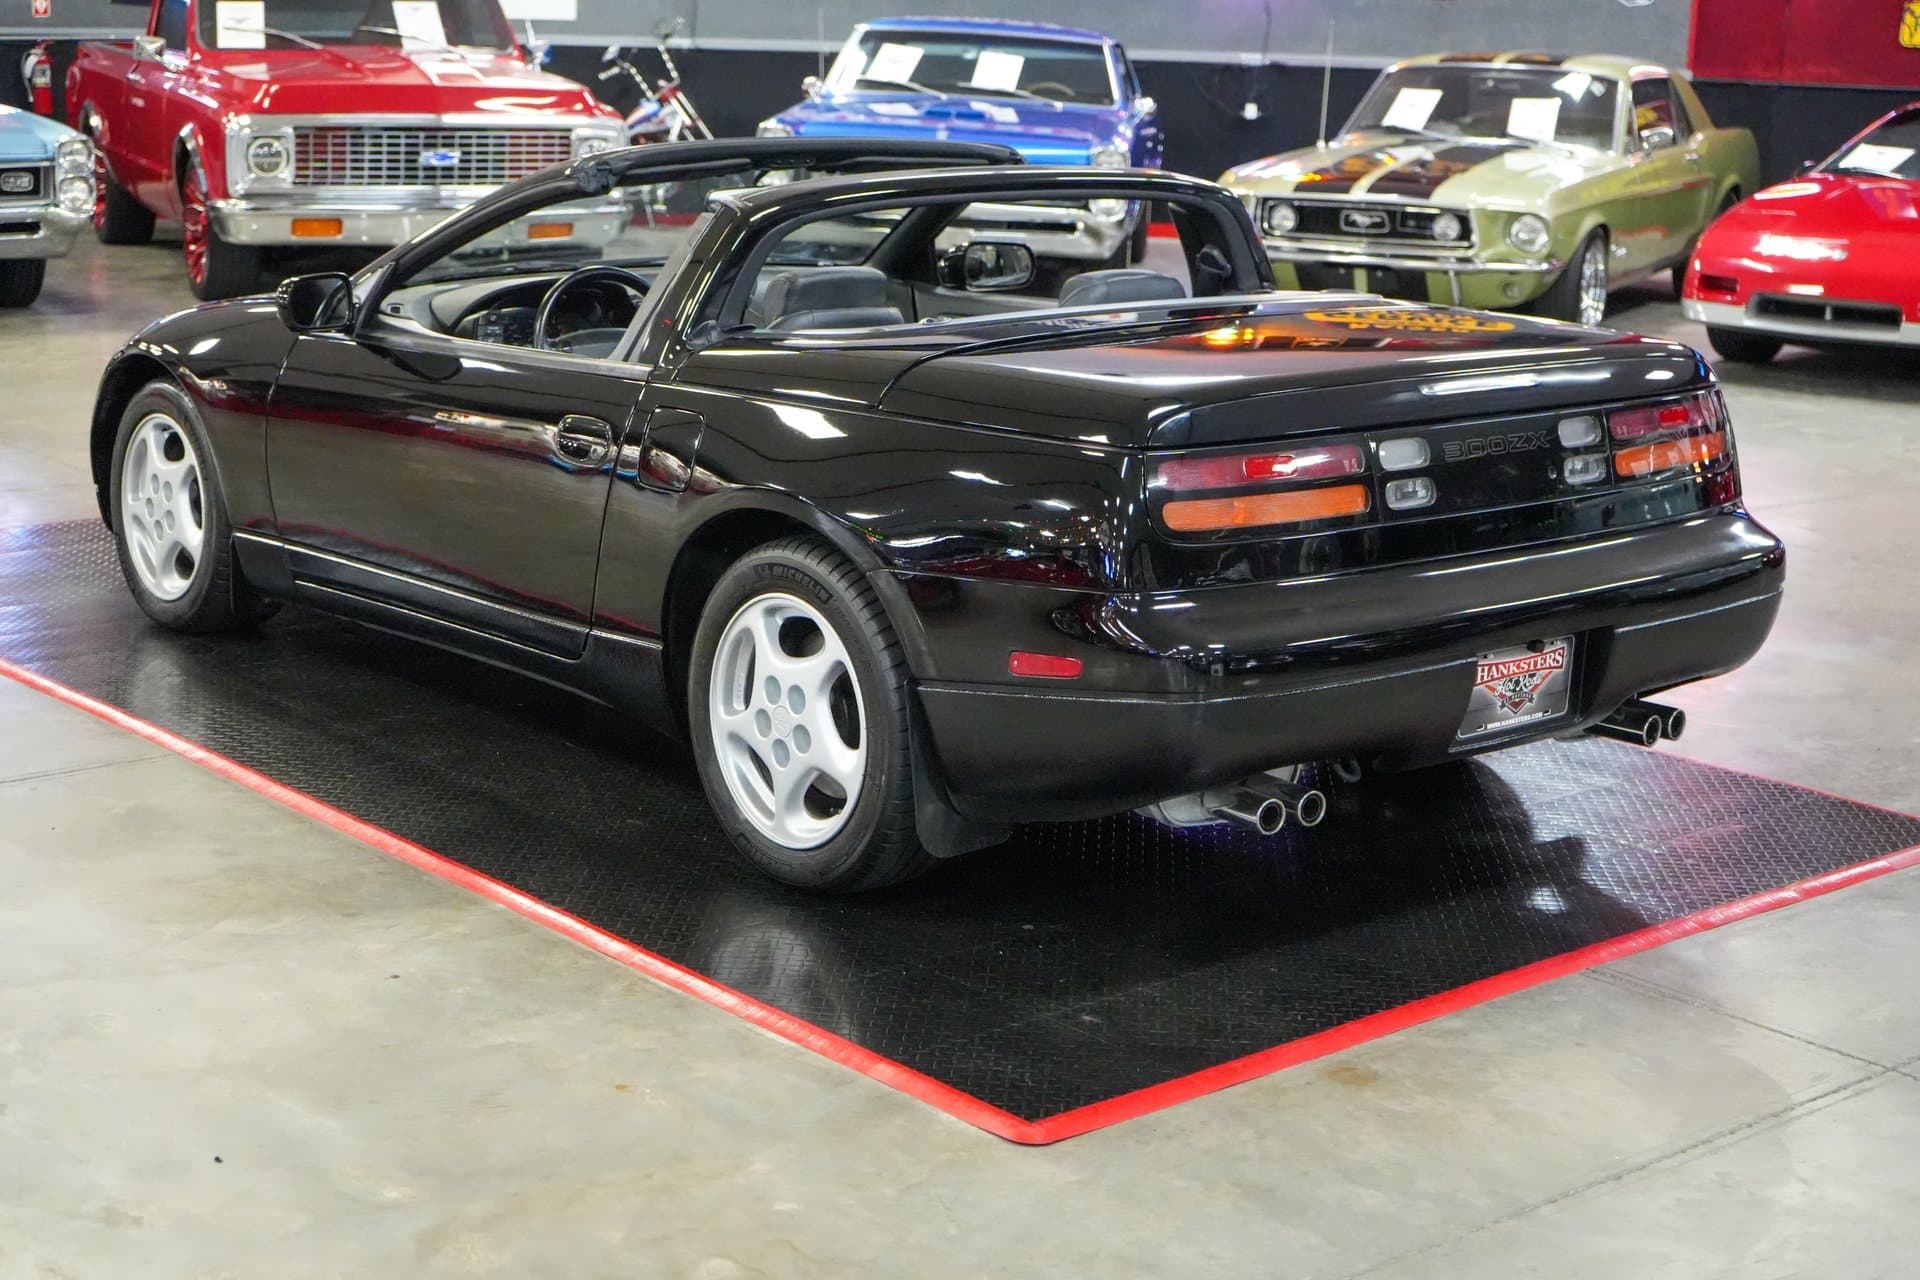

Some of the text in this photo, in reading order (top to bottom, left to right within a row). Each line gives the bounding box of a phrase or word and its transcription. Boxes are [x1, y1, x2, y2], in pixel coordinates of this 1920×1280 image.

[1443, 430, 1550, 462] 300ZX
[773, 565, 829, 602] MICHELIN
[1476, 649, 1563, 684] HANKSTERS
[1495, 677, 1516, 695] Hot
